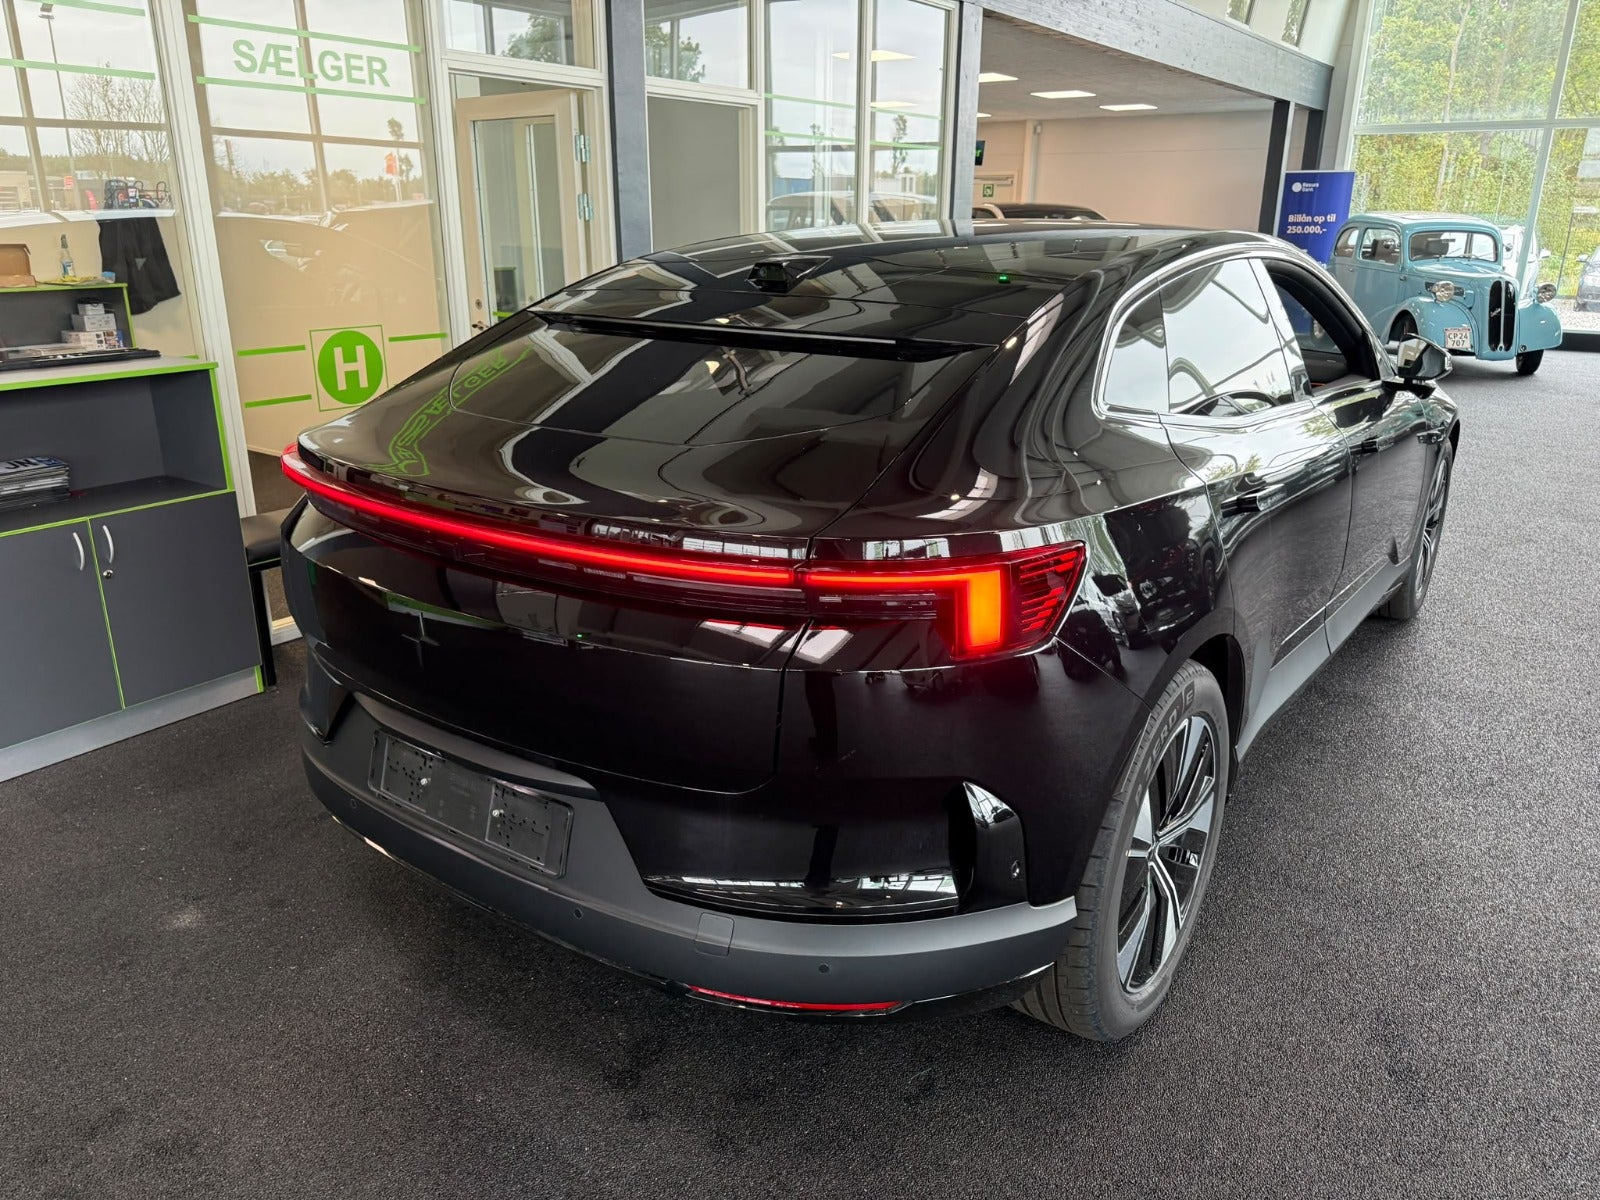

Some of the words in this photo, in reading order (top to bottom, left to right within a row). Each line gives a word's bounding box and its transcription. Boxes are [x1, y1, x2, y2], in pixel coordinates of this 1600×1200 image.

[232, 39, 391, 87] SÆLGER
[1286, 225, 1327, 234] 250.000,-
[1288, 213, 1312, 223] Billån
[1313, 216, 1325, 224] op
[1327, 213, 1336, 222] til
[333, 344, 369, 391] H
